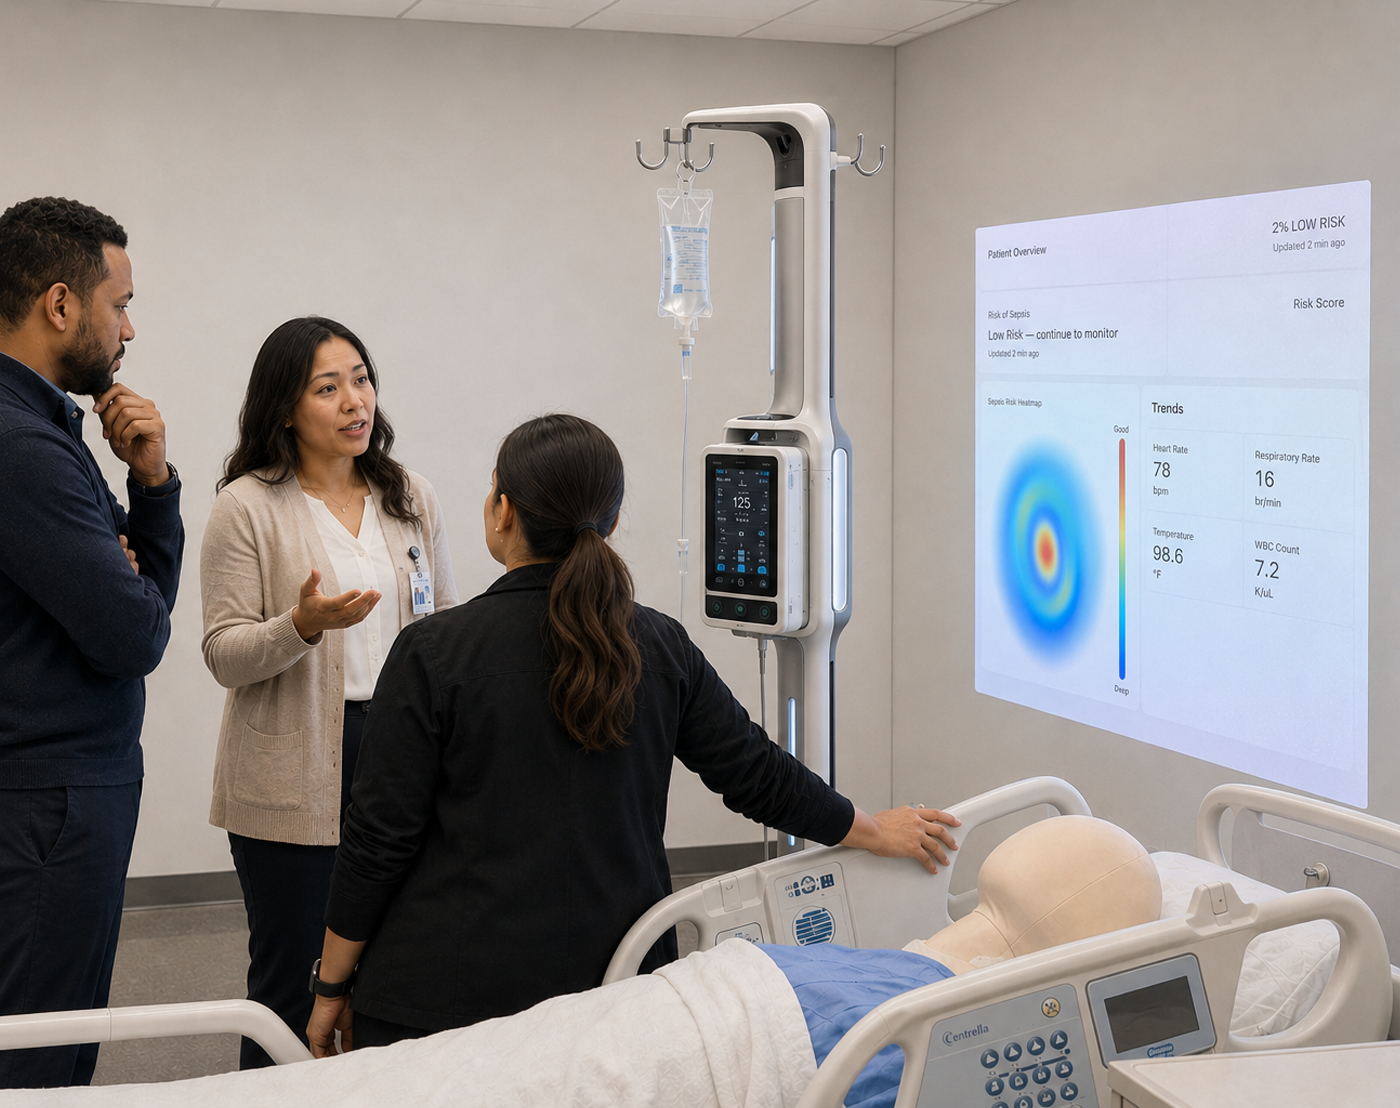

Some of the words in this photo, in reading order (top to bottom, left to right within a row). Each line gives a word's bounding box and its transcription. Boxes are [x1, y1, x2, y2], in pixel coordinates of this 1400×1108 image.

[1272, 221, 1289, 234] 2%
[1292, 218, 1317, 232] LOW
[1320, 215, 1345, 229] RISK
[988, 249, 1012, 259] Patient
[1013, 245, 1047, 257] Overview
[1273, 241, 1305, 253] Updated
[1307, 240, 1312, 249] 2
[1314, 239, 1329, 248] min
[1293, 298, 1313, 309] Risk
[1316, 297, 1345, 309] Score
[988, 330, 1005, 341] Low
[1006, 329, 1023, 340] Risk
[1036, 329, 1072, 340] continue
[1073, 329, 1083, 339] to
[1084, 327, 1119, 339] monitor
[1151, 402, 1184, 414] Trends
[1153, 444, 1171, 453] Heart
[1172, 444, 1188, 454] Rate
[1255, 450, 1300, 464] Respiratory
[1301, 453, 1320, 464] Rate
[1153, 461, 1170, 478] 78
[1256, 470, 1274, 488] 16
[1153, 486, 1169, 496] bpm
[733, 496, 751, 509] 125
[1153, 545, 1183, 564] 98.6
[1254, 540, 1274, 551] WBC
[1275, 543, 1300, 555] Count
[1255, 559, 1279, 579] 7.2
[942, 1024, 989, 1047] Centrella
